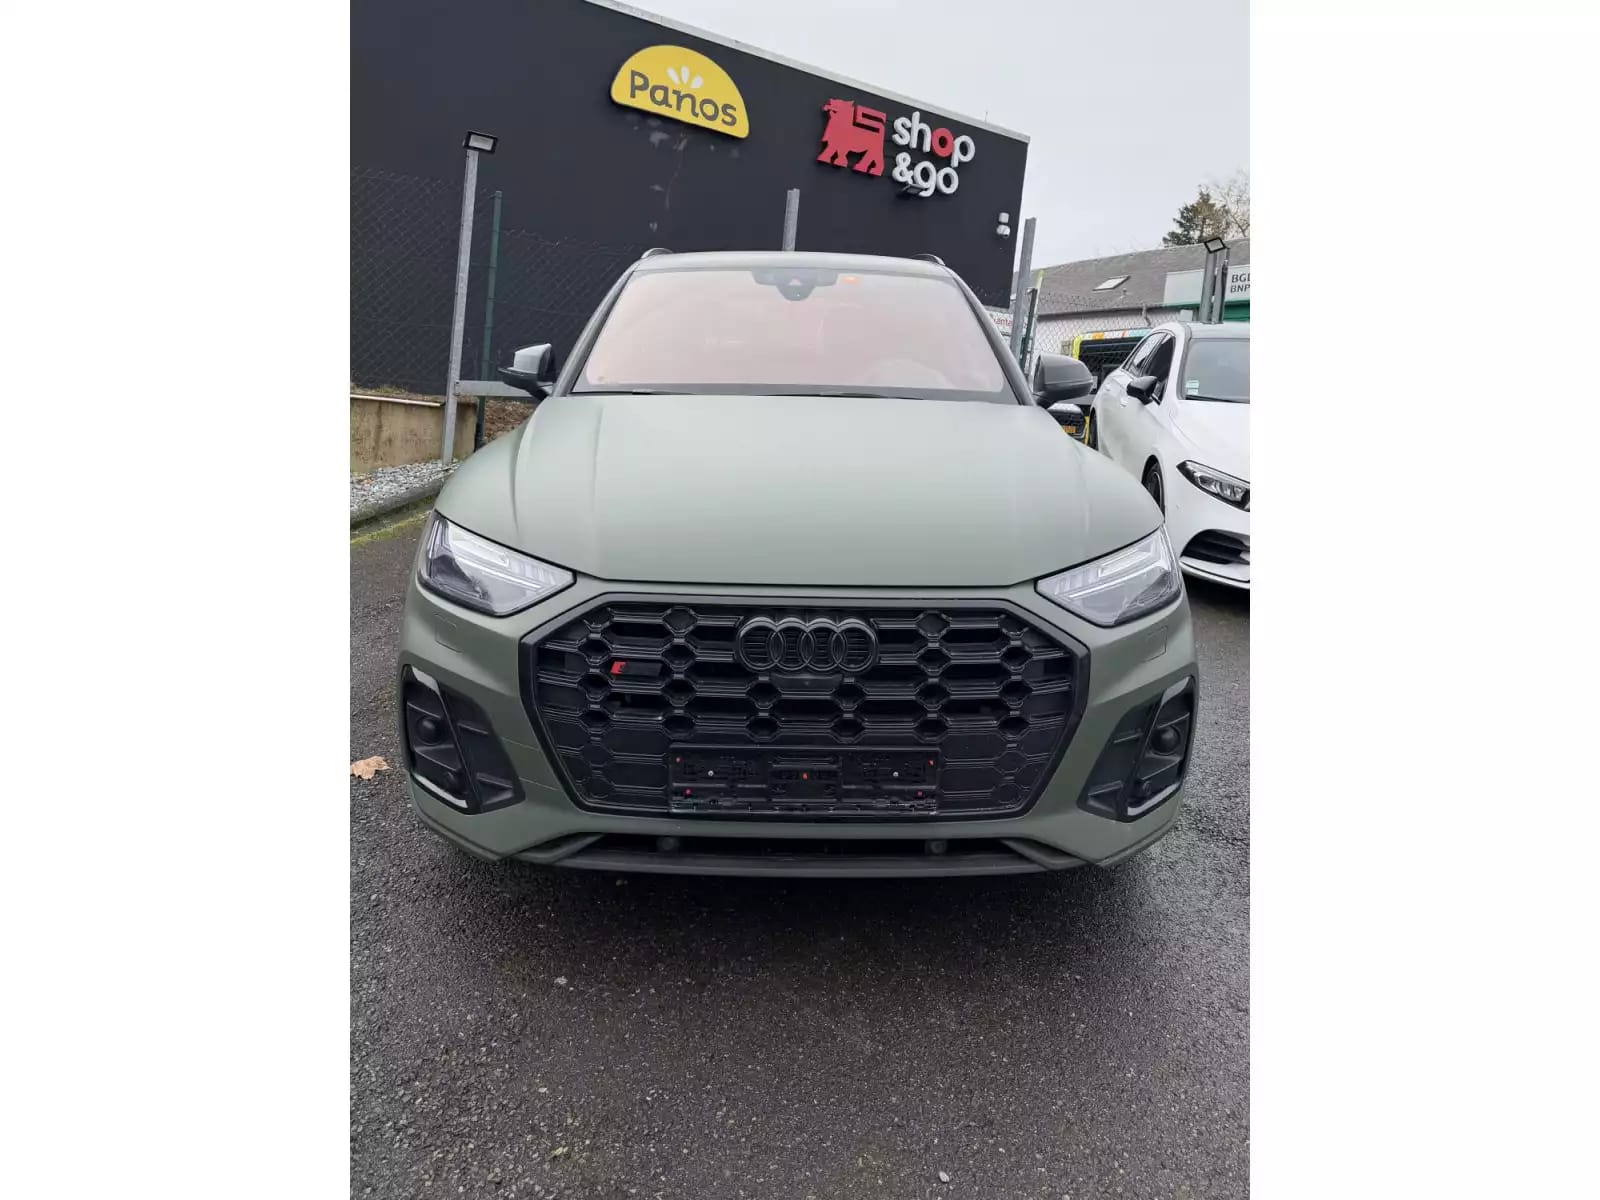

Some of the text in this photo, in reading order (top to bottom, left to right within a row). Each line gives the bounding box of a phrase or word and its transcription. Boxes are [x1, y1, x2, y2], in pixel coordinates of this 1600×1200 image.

[629, 69, 737, 127] Panos
[892, 111, 976, 168] shop
[892, 152, 959, 197] &go
